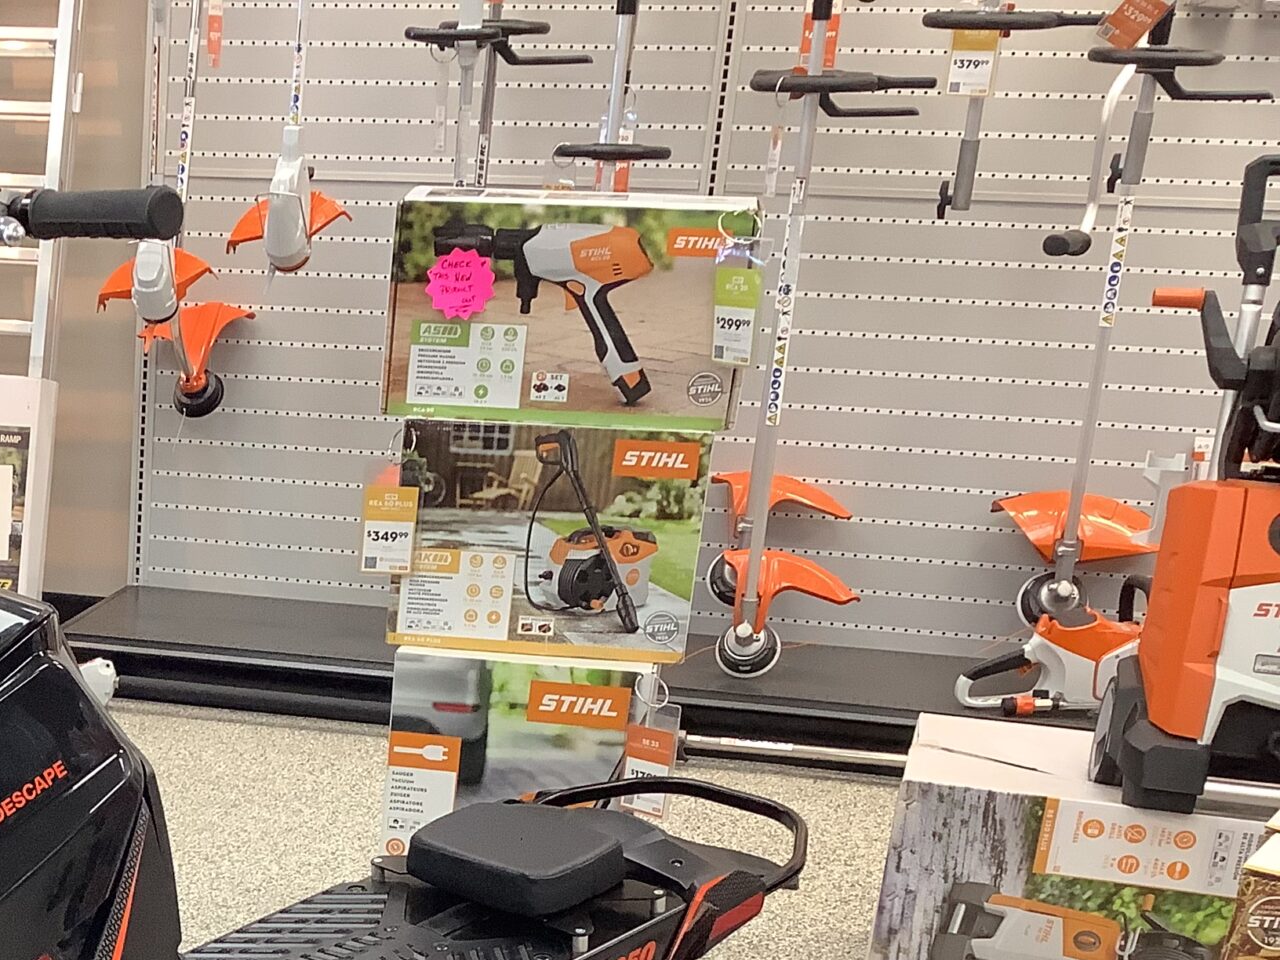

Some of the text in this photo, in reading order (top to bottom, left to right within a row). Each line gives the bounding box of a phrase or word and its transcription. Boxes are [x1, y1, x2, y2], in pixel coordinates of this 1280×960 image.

[441, 259, 472, 269] CHECK
[688, 383, 722, 395] STIHL
[0, 434, 22, 444] RAMP
[621, 450, 690, 469] STIHL
[645, 623, 678, 633] STIHL
[538, 693, 619, 718] STIHL
